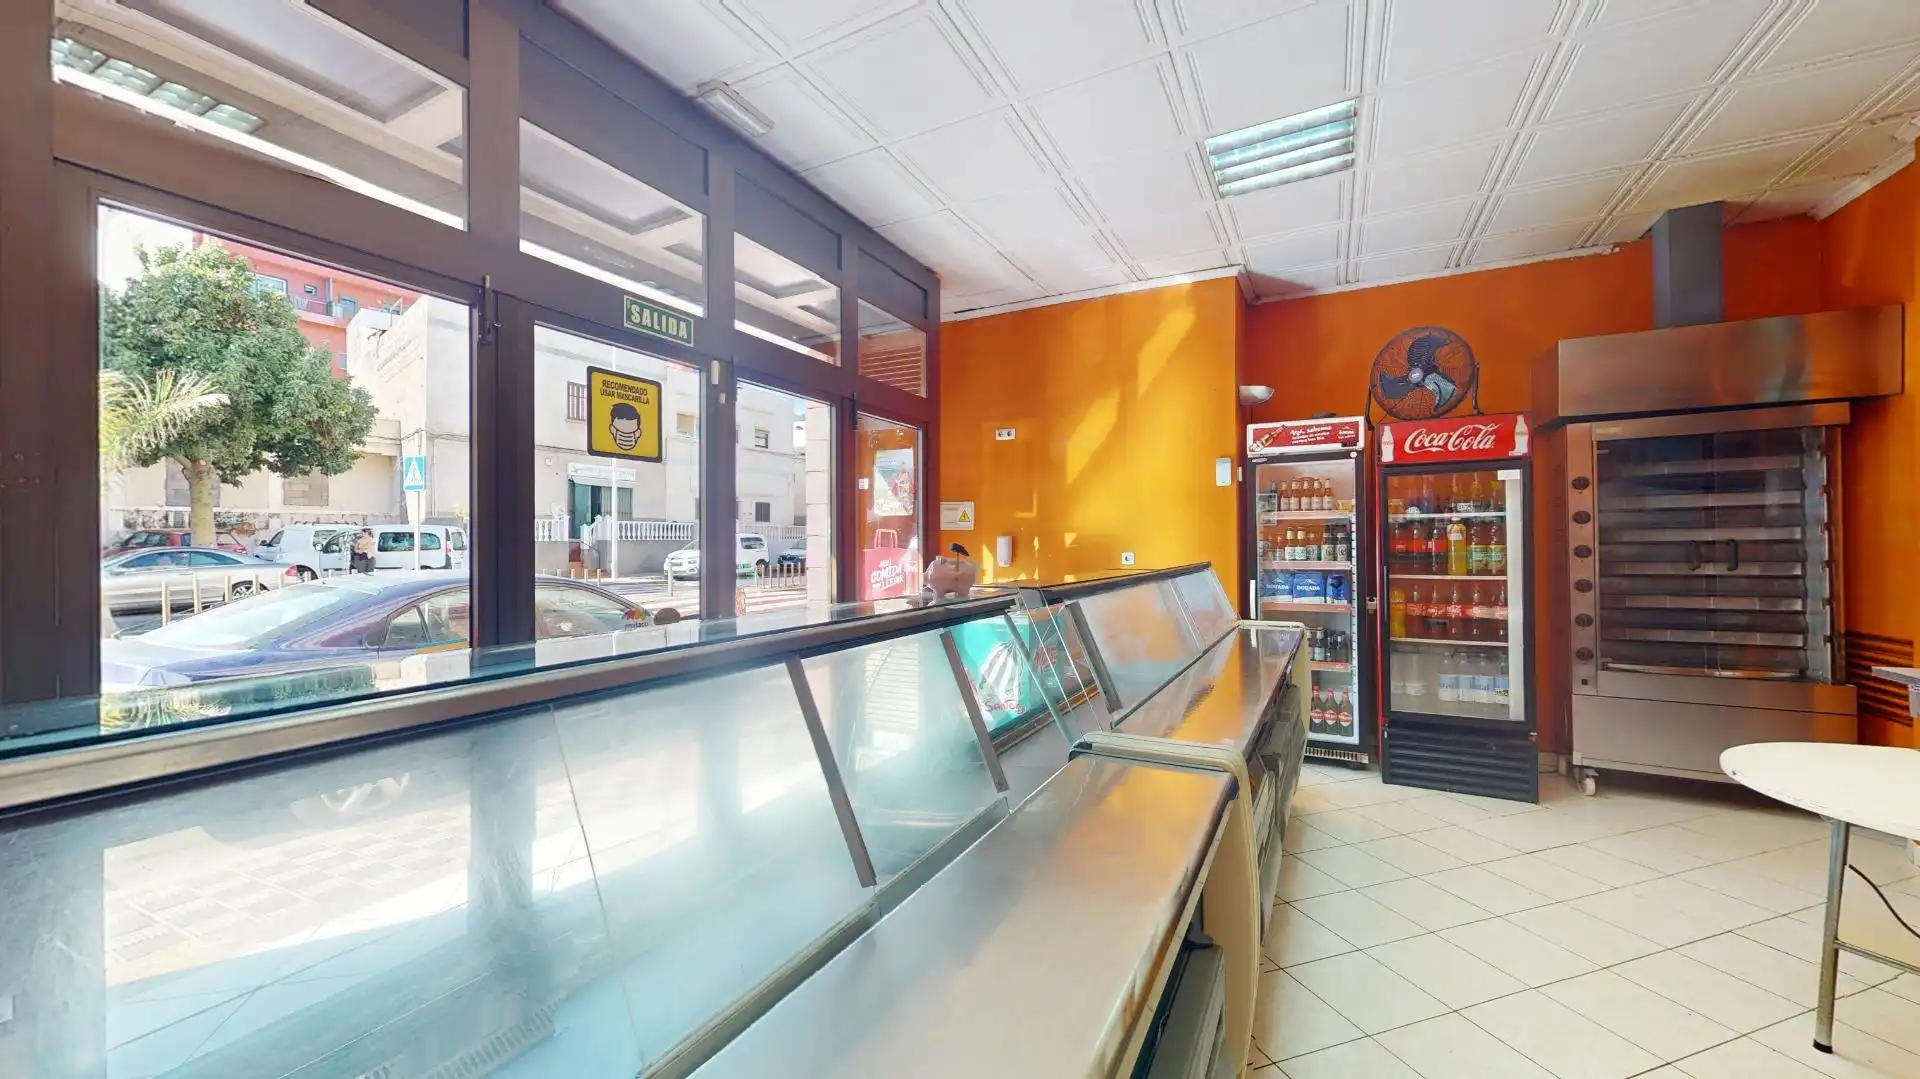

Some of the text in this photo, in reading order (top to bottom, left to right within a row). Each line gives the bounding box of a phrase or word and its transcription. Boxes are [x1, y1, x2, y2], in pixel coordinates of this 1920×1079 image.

[631, 304, 688, 339] SALIDA
[600, 389, 650, 405] USAR MASCARILLA
[602, 379, 648, 396] RECOMENDADO
[1404, 423, 1500, 454] Coca-Cola
